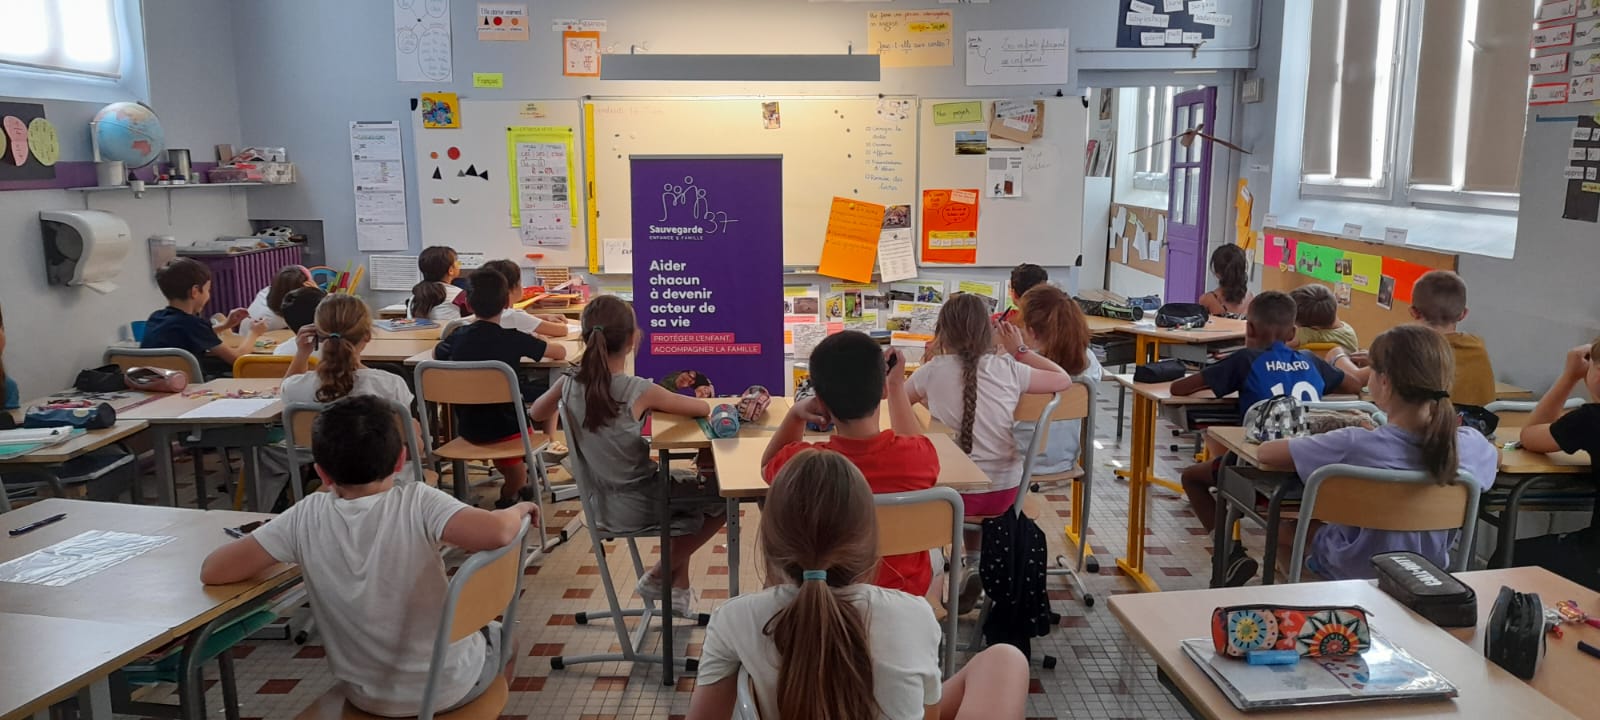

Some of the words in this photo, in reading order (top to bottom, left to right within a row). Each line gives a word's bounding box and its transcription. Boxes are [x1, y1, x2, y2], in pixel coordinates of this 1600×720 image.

[649, 225, 703, 235] Sauvegarde
[649, 260, 687, 271] Aider
[649, 274, 700, 286] chacun
[650, 288, 660, 300] à
[662, 288, 713, 300] devenir
[650, 303, 696, 314] acteur
[698, 302, 716, 314] de
[650, 318, 667, 328] sa
[670, 315, 691, 328] vie
[1266, 360, 1310, 372] HAZARD
